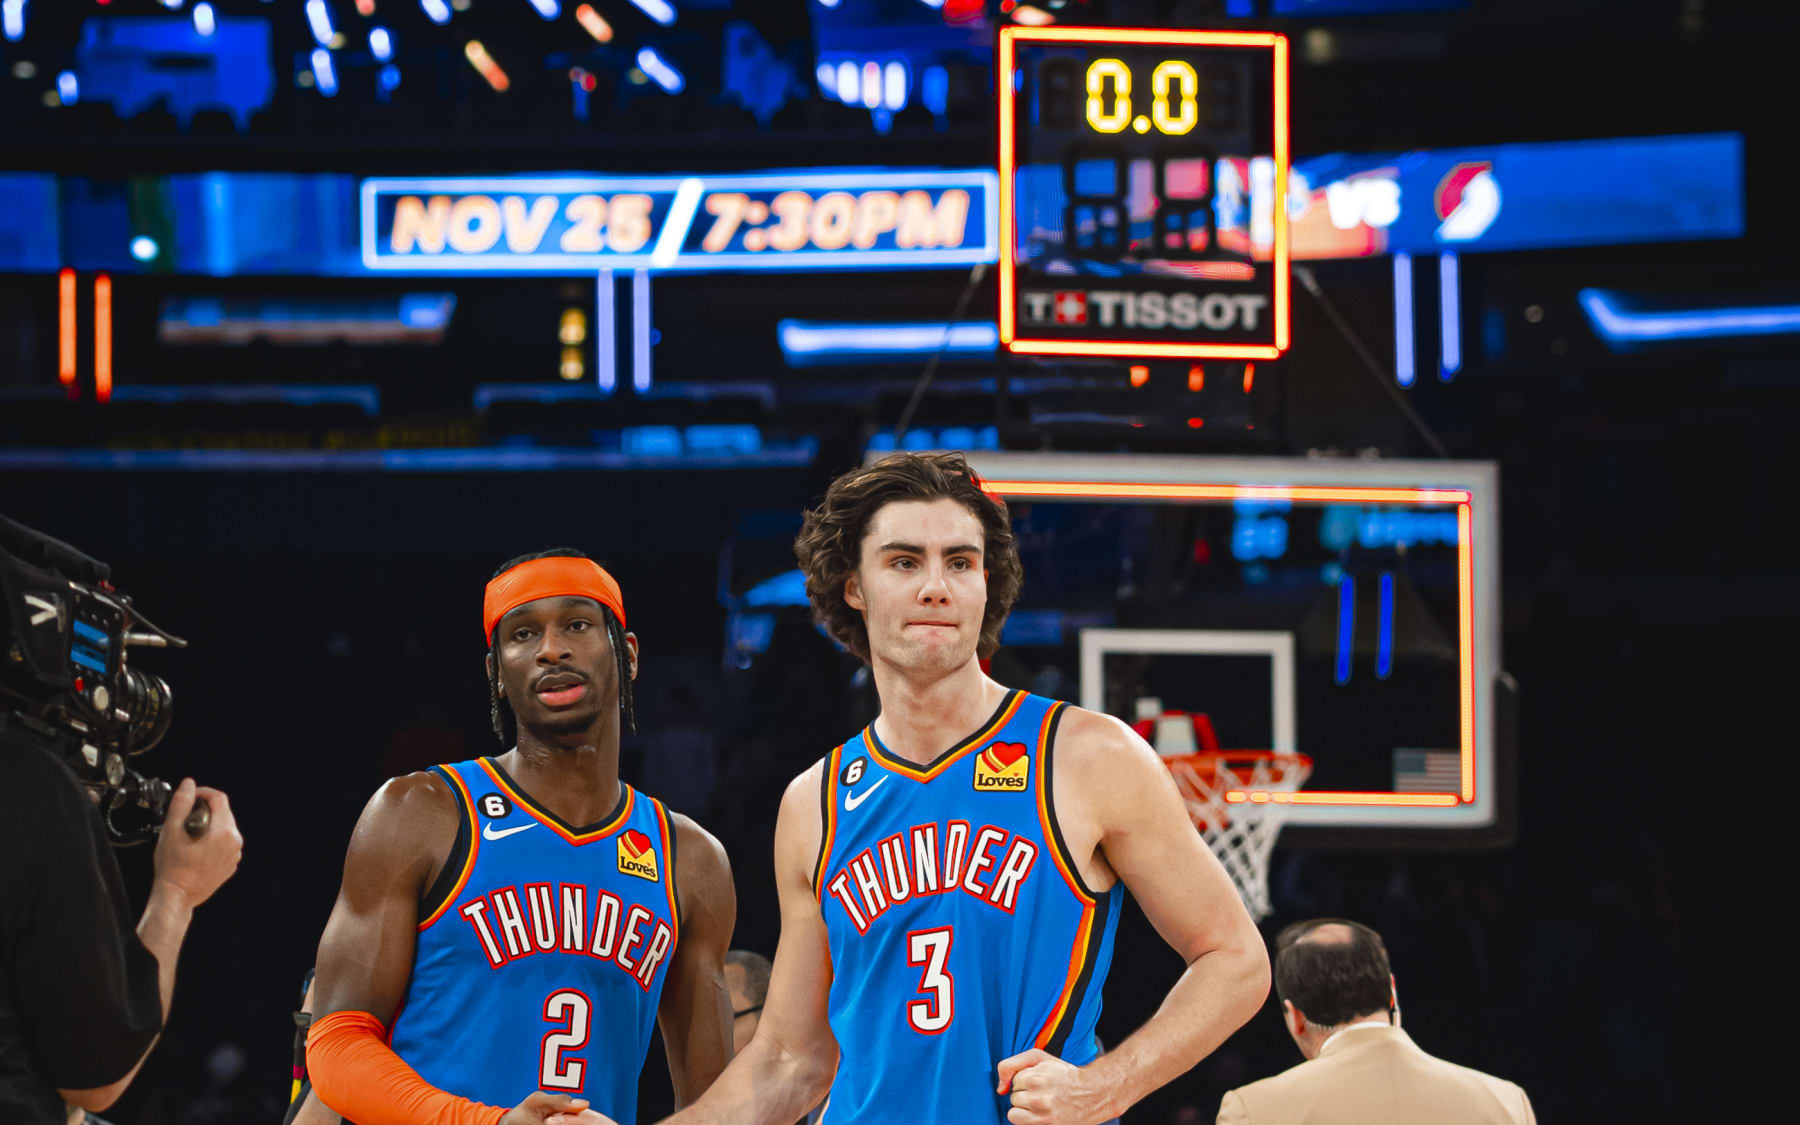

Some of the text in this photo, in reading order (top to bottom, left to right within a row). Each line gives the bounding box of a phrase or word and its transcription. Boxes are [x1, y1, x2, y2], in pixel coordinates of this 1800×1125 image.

[1086, 58, 1198, 135] 0.0
[391, 188, 970, 253] NOV 25 7:30PM
[1090, 291, 1267, 330] TISSOT
[484, 795, 506, 818] 6
[845, 759, 864, 785] 6
[827, 819, 1040, 937] THUNDER
[457, 881, 673, 993] THUNDER
[906, 925, 954, 1035] 3
[538, 987, 592, 1094] 2
